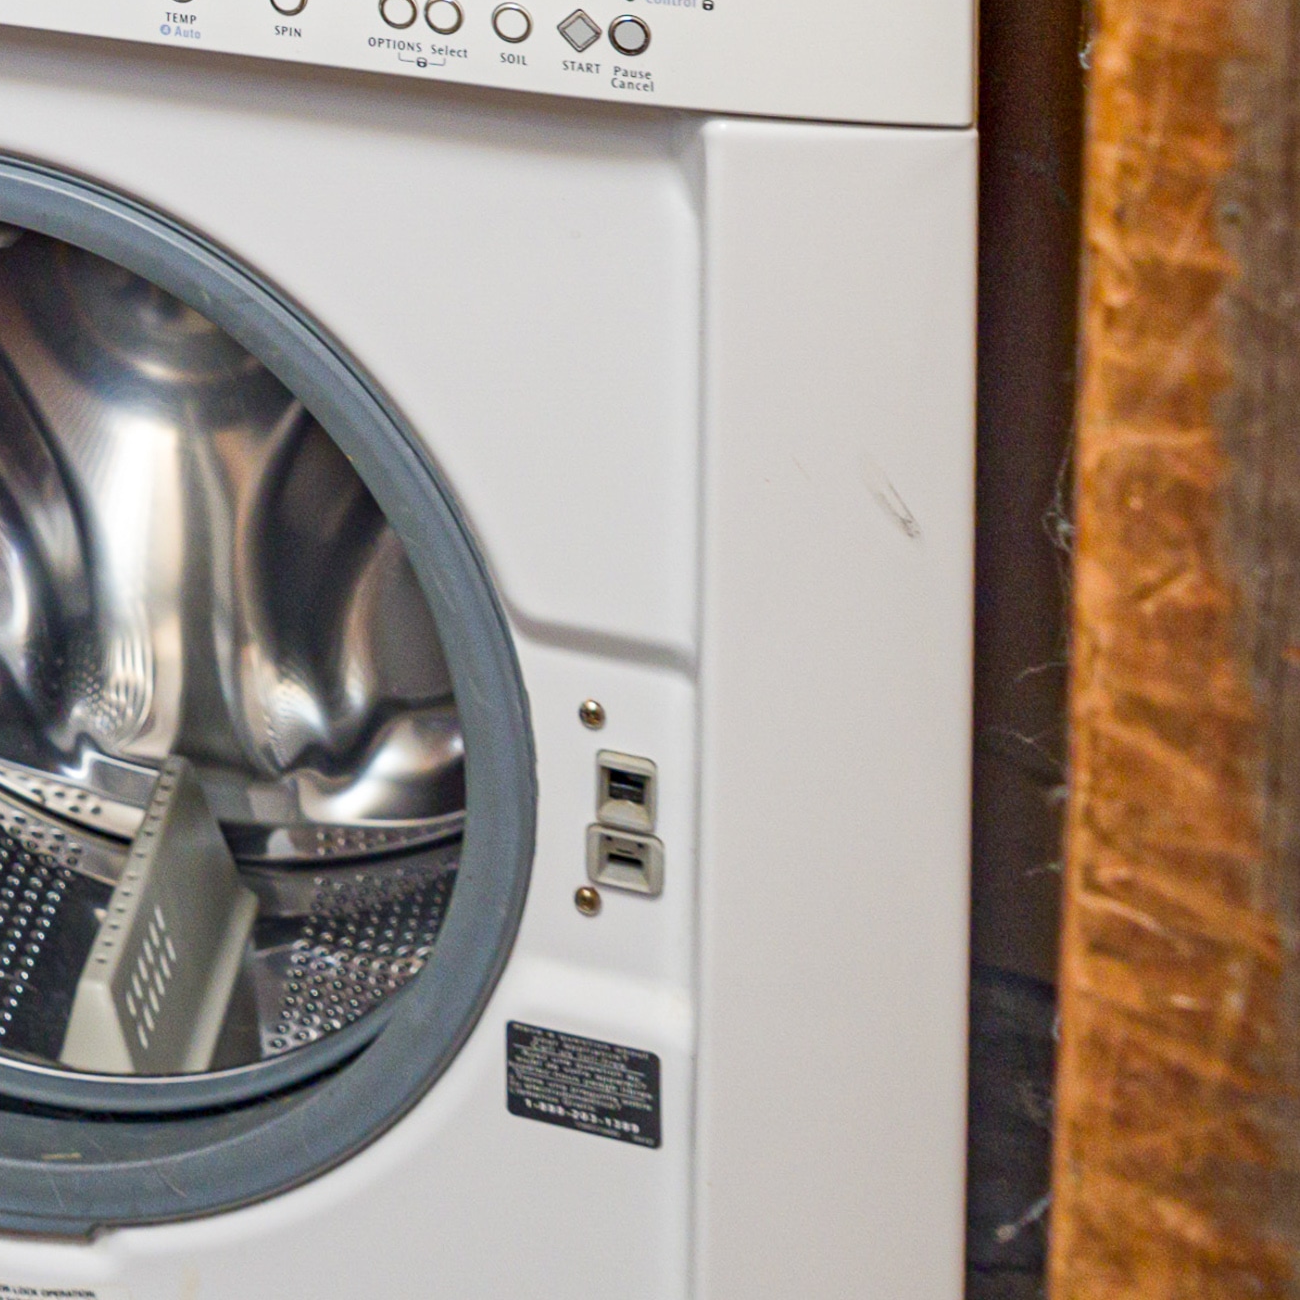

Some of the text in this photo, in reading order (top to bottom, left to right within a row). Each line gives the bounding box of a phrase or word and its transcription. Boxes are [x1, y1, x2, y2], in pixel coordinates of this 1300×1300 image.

[165, 11, 197, 25] TEMP
[174, 25, 201, 40] Auto
[274, 24, 302, 38] SPIN
[368, 36, 468, 59] OPTIONS Select
[499, 52, 528, 66] SOIL
[562, 60, 601, 74] START
[613, 65, 652, 80] Pause
[610, 76, 655, 92] Cancel
